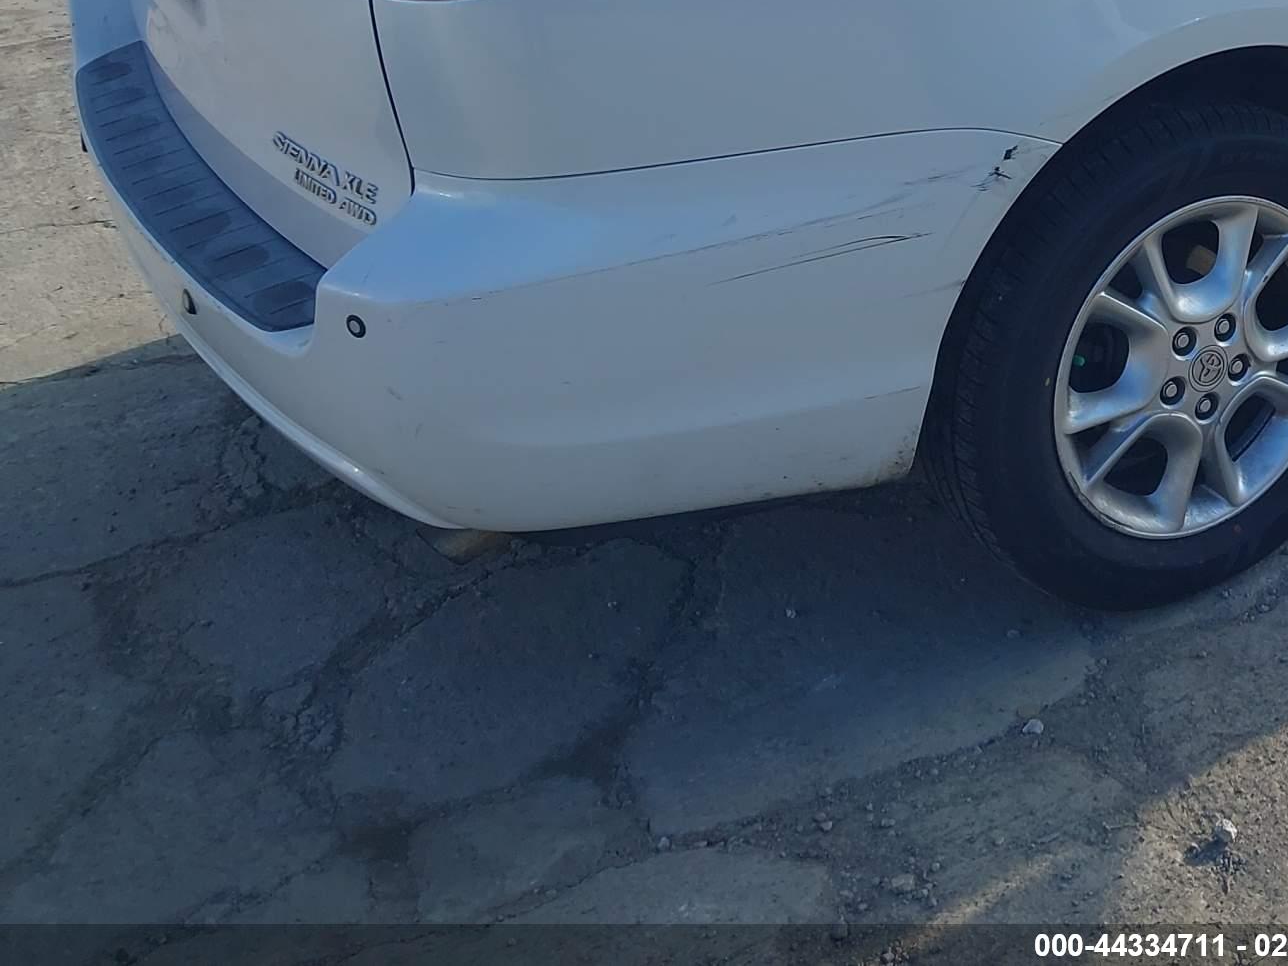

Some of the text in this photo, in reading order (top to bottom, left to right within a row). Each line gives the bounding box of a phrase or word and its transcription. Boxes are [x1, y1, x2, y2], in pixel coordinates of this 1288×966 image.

[272, 131, 379, 205] SIENNA XLE
[294, 167, 377, 226] LIMITED AWD
